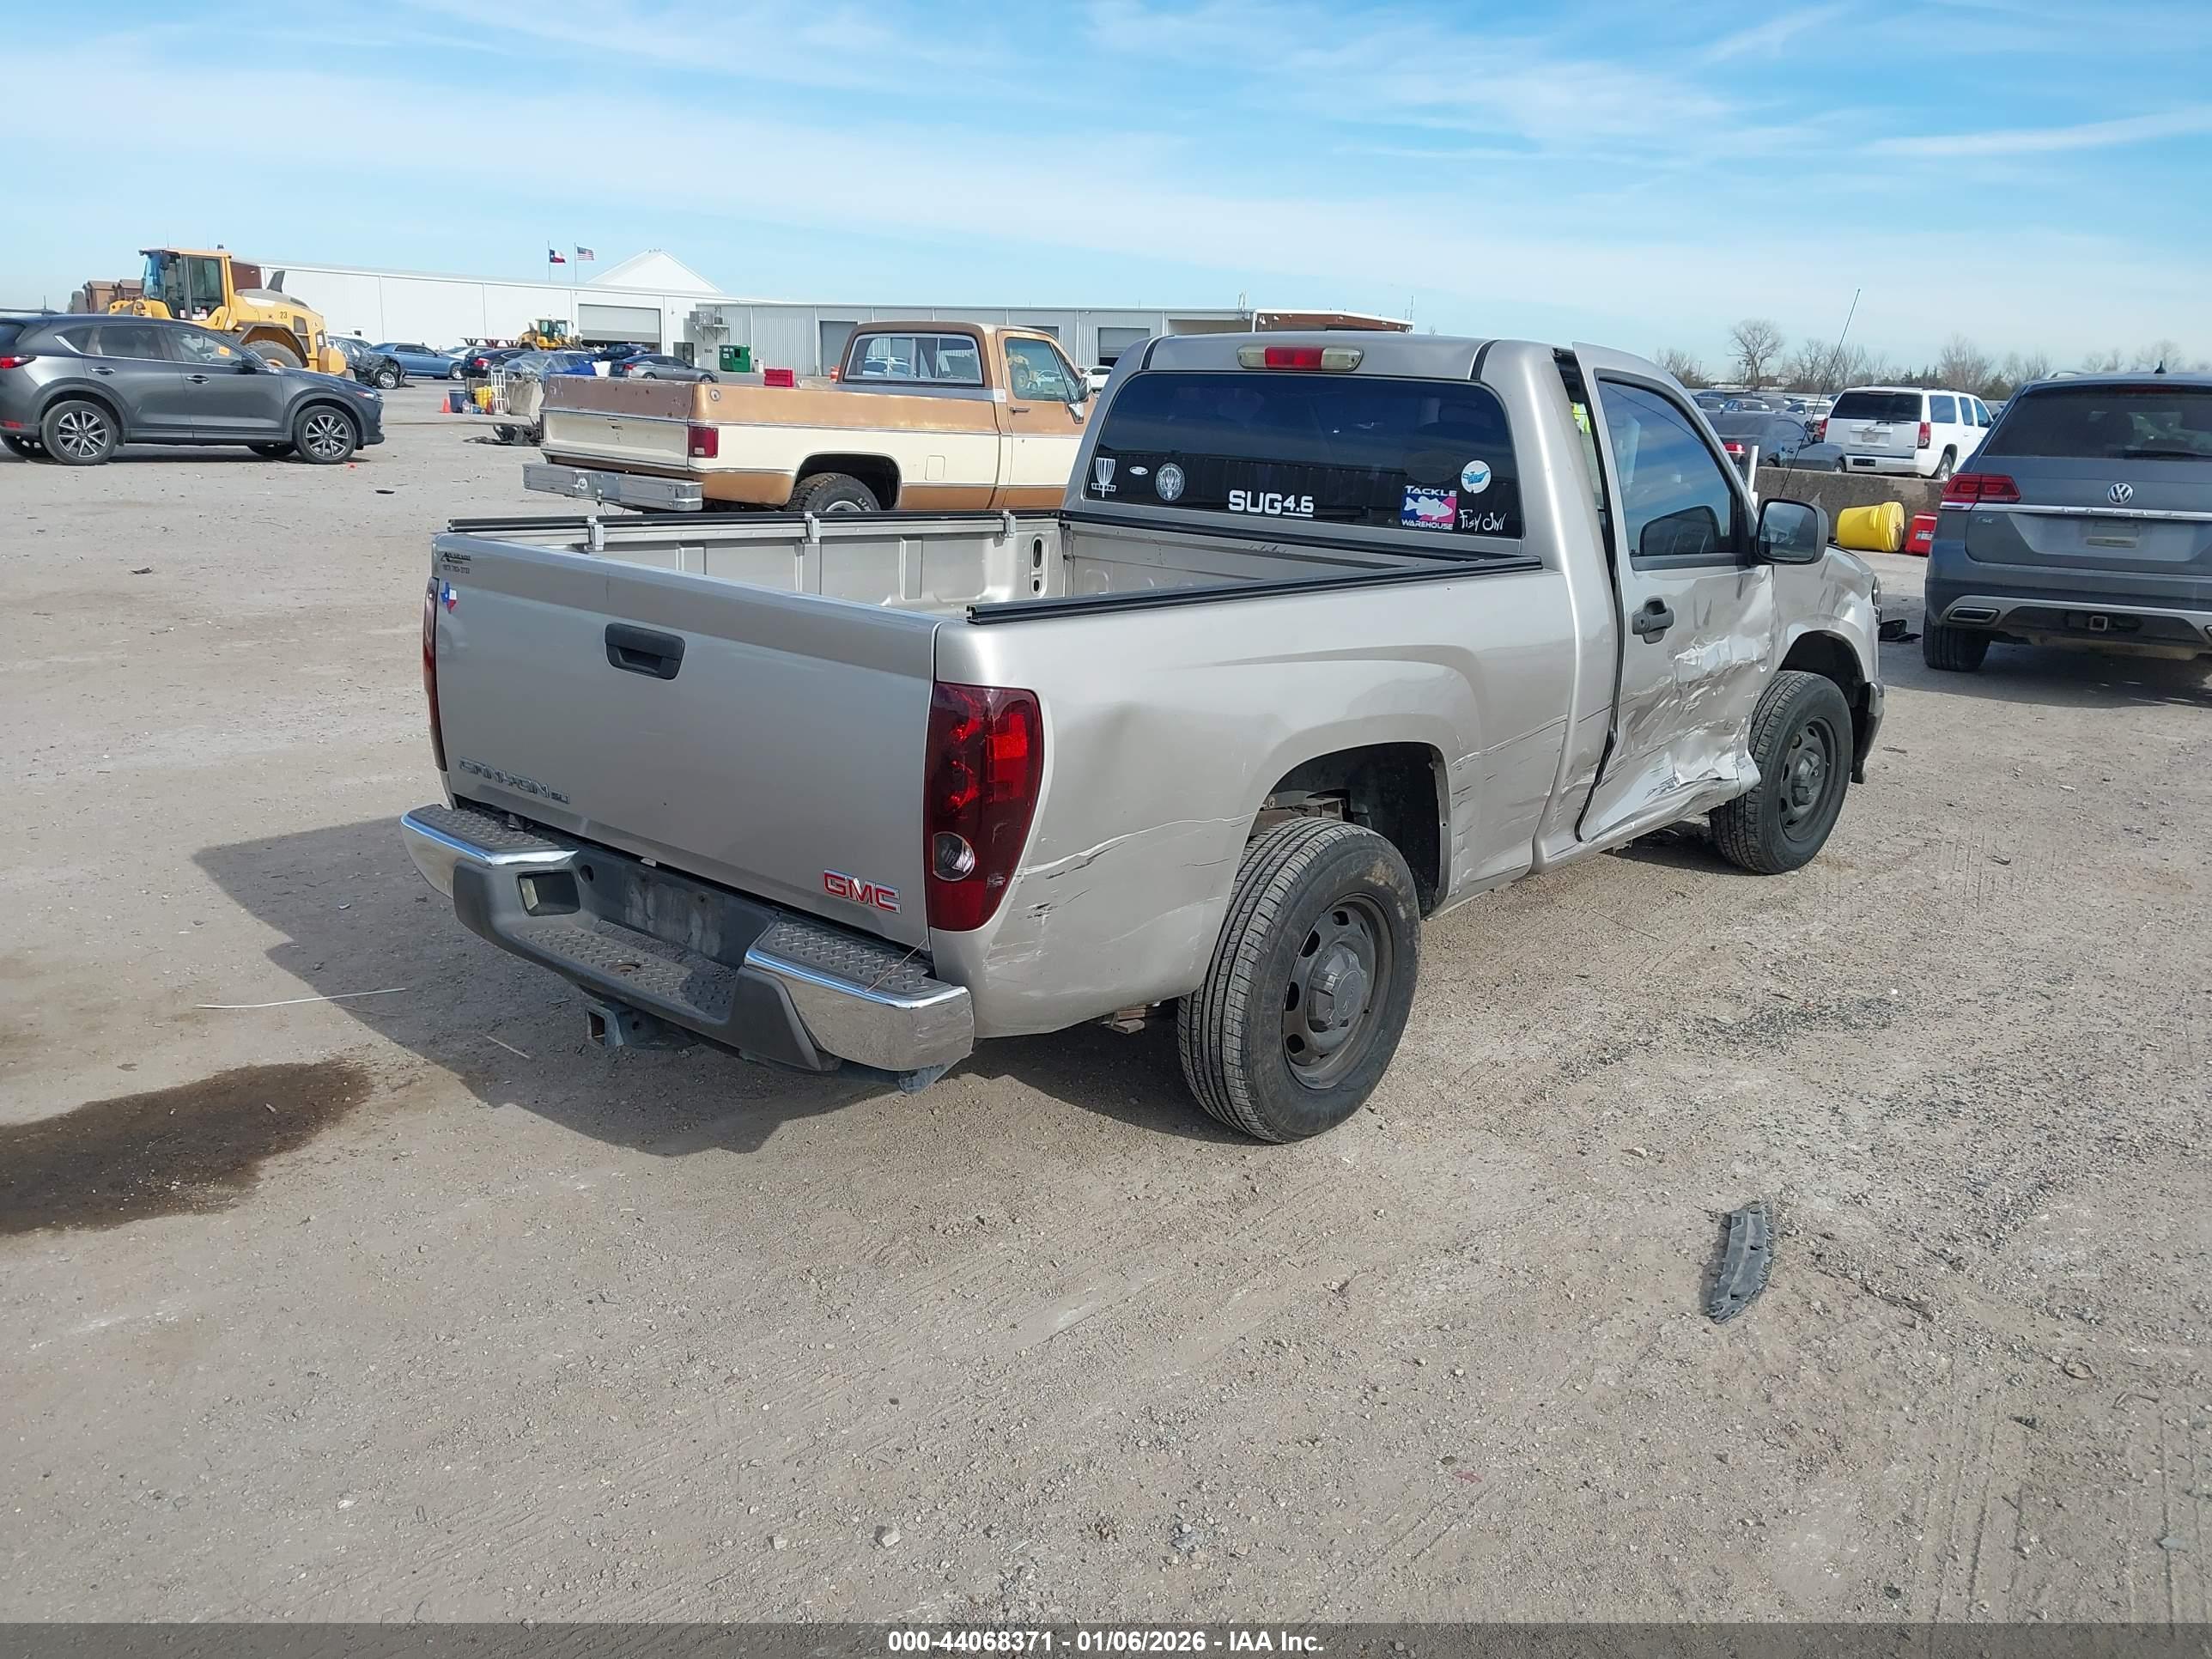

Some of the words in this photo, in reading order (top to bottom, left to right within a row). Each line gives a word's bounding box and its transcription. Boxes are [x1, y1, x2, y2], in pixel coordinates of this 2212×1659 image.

[1404, 485, 1457, 497] TACKLE
[1401, 519, 1454, 531] WAREHOUSE
[459, 757, 550, 798] CANYON
[823, 868, 901, 915] GMC
